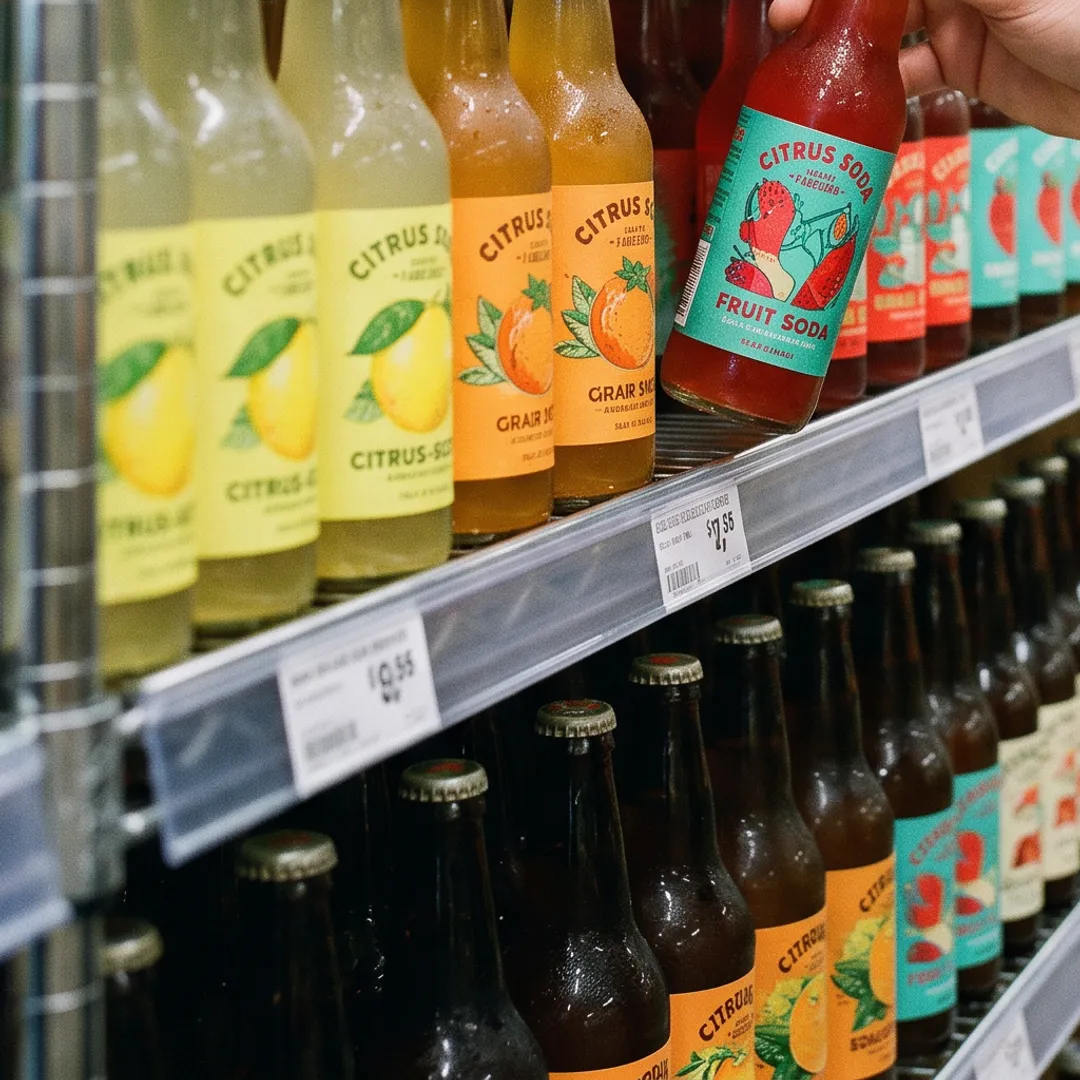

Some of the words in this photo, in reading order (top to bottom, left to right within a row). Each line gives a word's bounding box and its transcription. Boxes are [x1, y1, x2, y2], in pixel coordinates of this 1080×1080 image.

[760, 141, 837, 170] CITRUS
[839, 153, 874, 205] SODA
[479, 207, 544, 262] CITRUS
[574, 195, 641, 246] CITRUS
[349, 223, 428, 280] CITRUS
[715, 291, 777, 326] FRUIT
[780, 314, 829, 341] SODA
